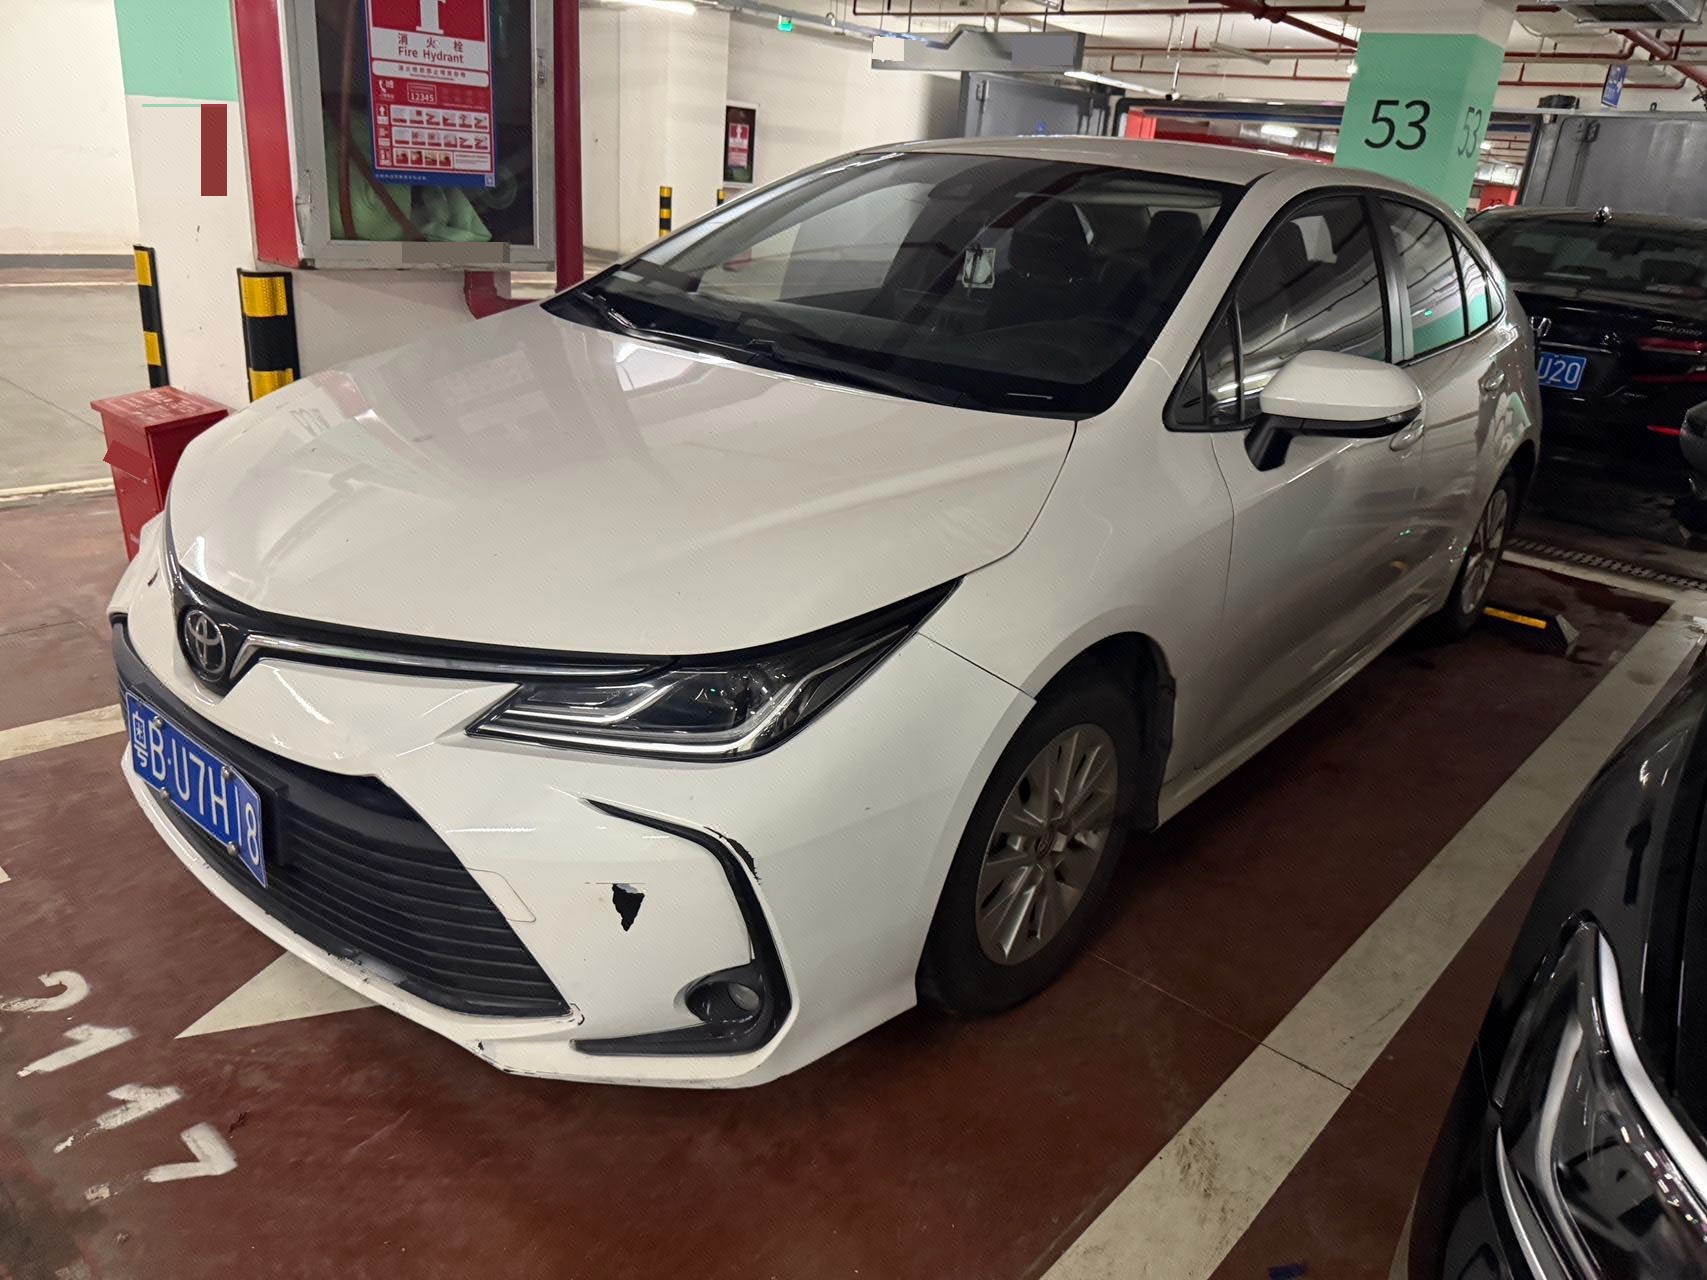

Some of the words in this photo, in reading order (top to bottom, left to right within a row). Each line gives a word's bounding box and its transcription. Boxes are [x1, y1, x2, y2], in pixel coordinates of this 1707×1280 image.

[398, 32, 464, 53] 消火栓
[398, 46, 418, 58] Fire
[423, 49, 464, 63] Hydrant
[410, 92, 434, 102] 12345
[1364, 99, 1431, 150] 53
[1457, 106, 1482, 159] 53
